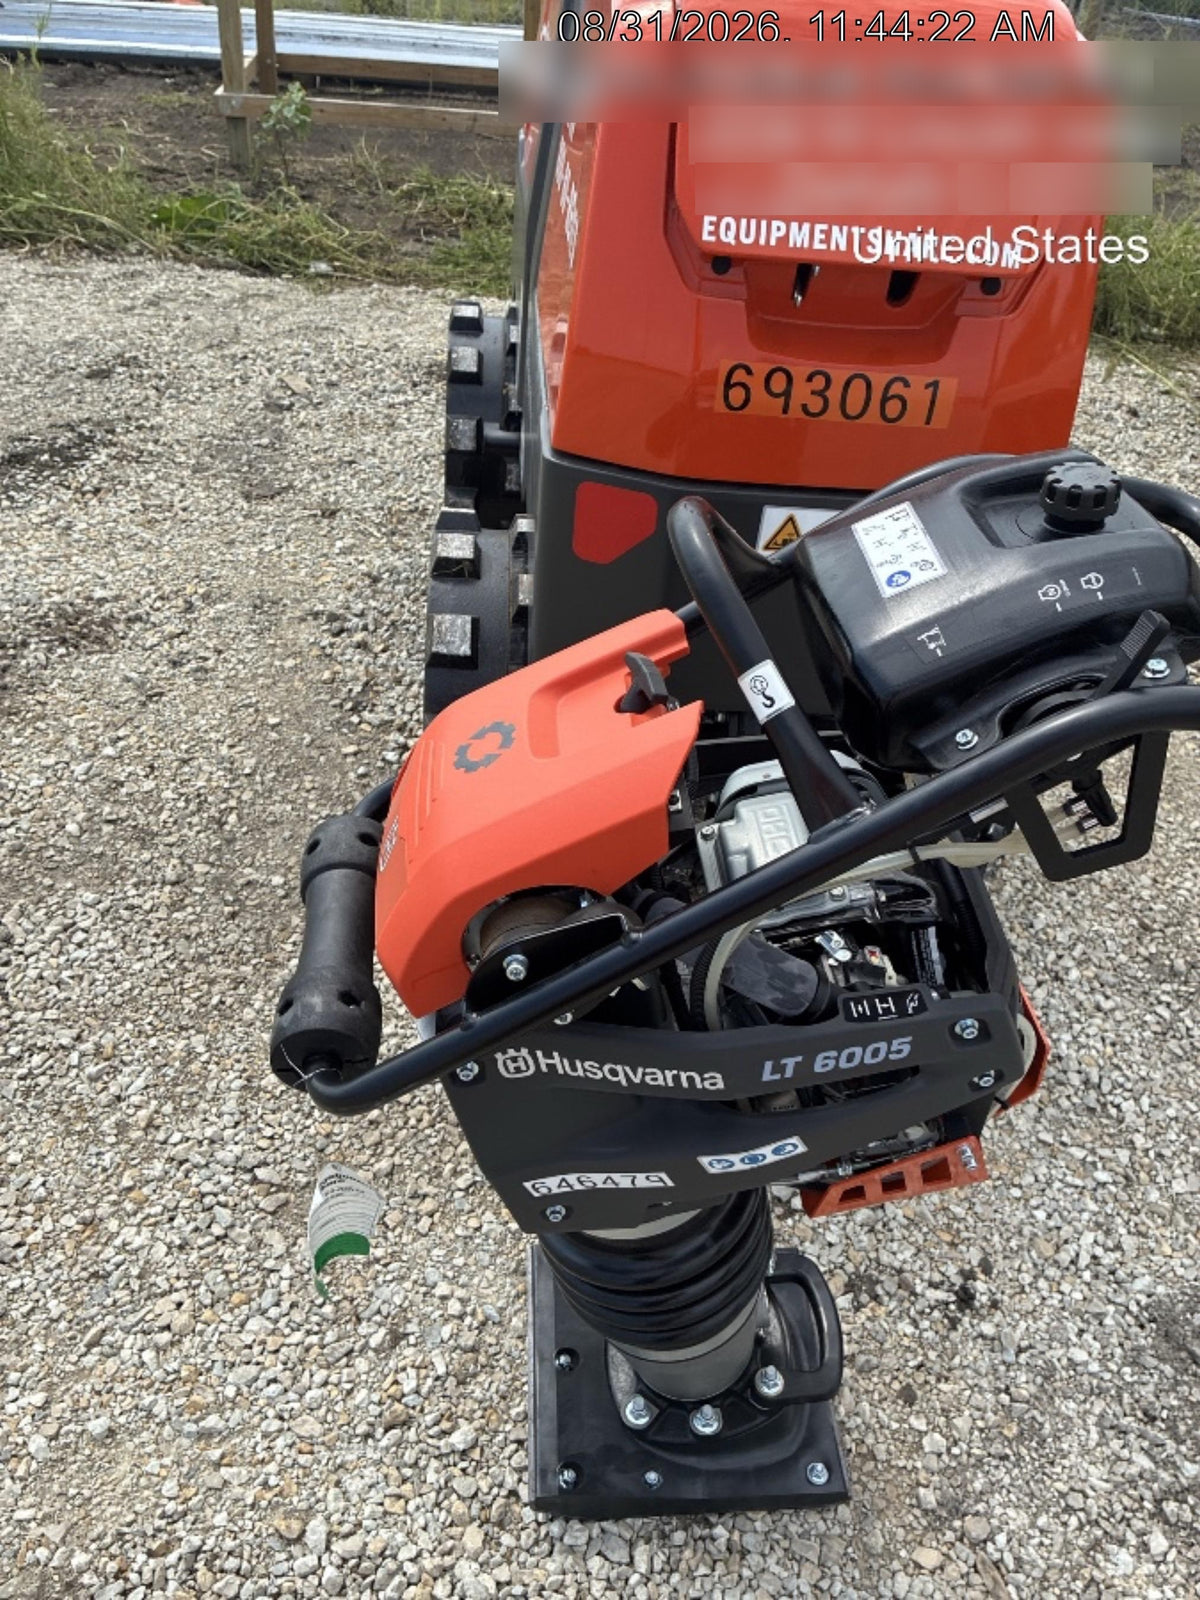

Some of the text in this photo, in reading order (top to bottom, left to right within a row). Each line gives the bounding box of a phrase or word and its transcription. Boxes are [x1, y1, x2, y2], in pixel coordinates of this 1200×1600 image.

[723, 363, 940, 426] 693061
[535, 1050, 725, 1090] Husqvarna
[761, 1036, 913, 1082] LT 6005
[531, 1174, 668, 1195] 646479
